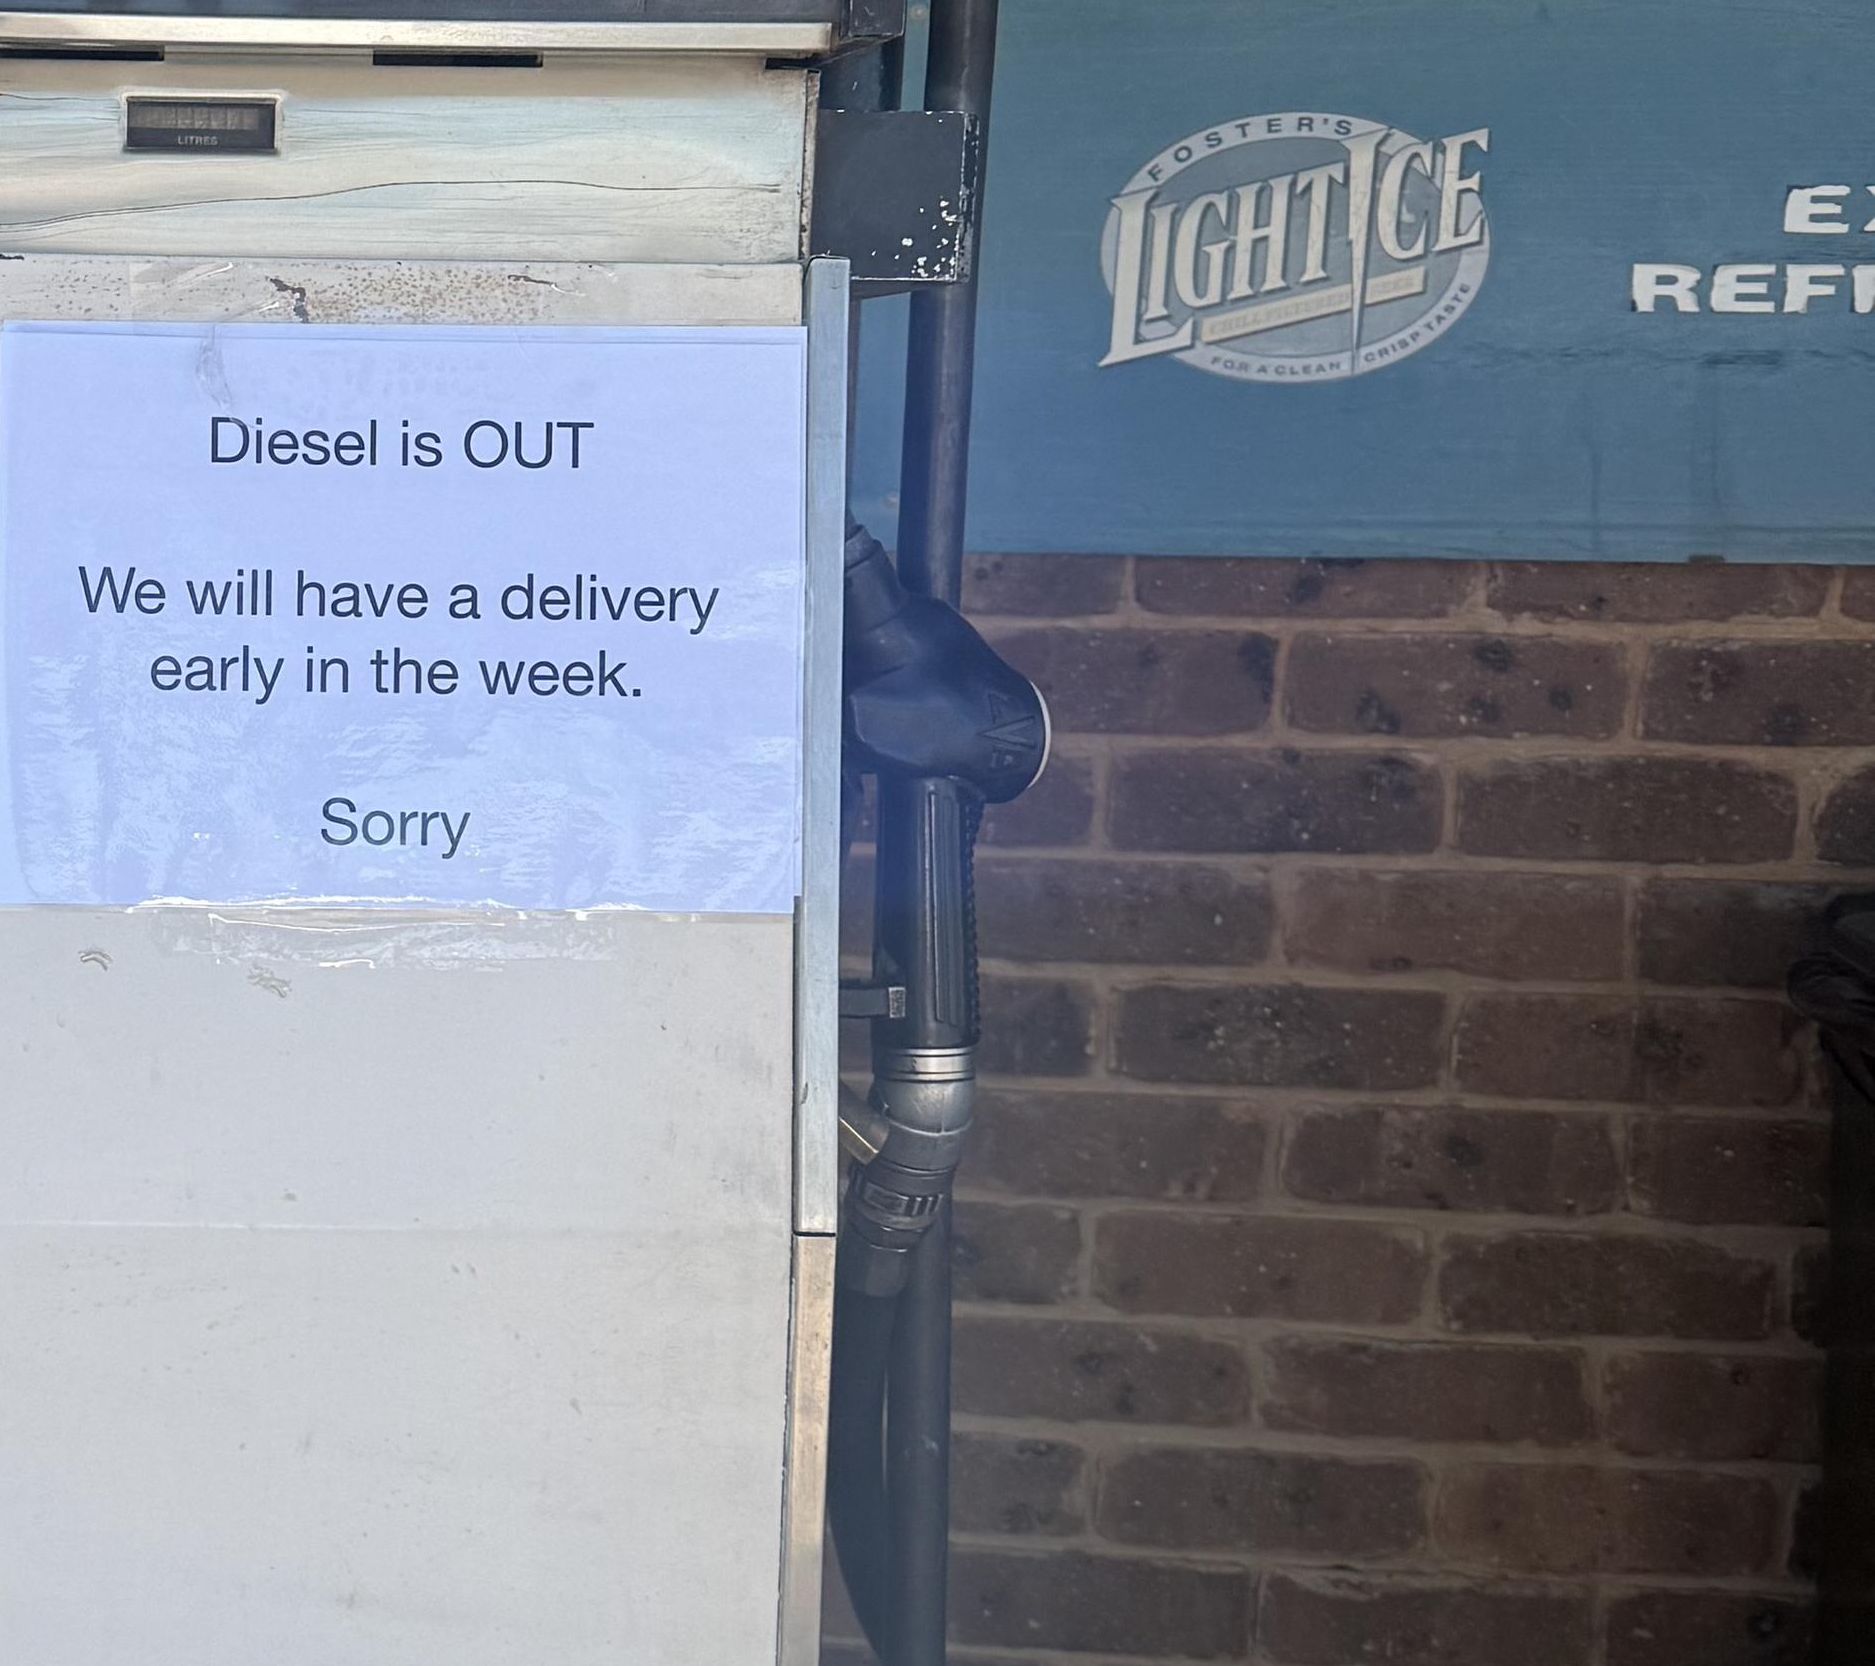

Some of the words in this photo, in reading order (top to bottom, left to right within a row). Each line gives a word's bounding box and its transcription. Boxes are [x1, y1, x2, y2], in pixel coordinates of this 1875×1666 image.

[178, 134, 219, 146] LITRES
[1147, 116, 1353, 183] FOSTER'S
[1783, 185, 1875, 233] E
[1098, 160, 1345, 367] LIGHT
[1339, 128, 1489, 353] ICE
[1210, 354, 1250, 373] FOR
[1257, 364, 1269, 375] A
[1274, 360, 1342, 376] CLEAN
[1363, 330, 1422, 364] CRISP
[1427, 283, 1472, 331] TASTE
[210, 416, 377, 467] Diesel
[401, 419, 443, 468] is
[463, 419, 595, 470] OUT
[77, 565, 167, 615] We
[185, 568, 273, 616] will
[296, 569, 429, 619] have
[448, 583, 482, 620] a
[500, 572, 720, 636] delivery
[150, 644, 285, 706] early
[305, 645, 349, 694] in
[369, 646, 460, 695] the
[478, 649, 642, 698] week.
[320, 797, 471, 860] Sorry
